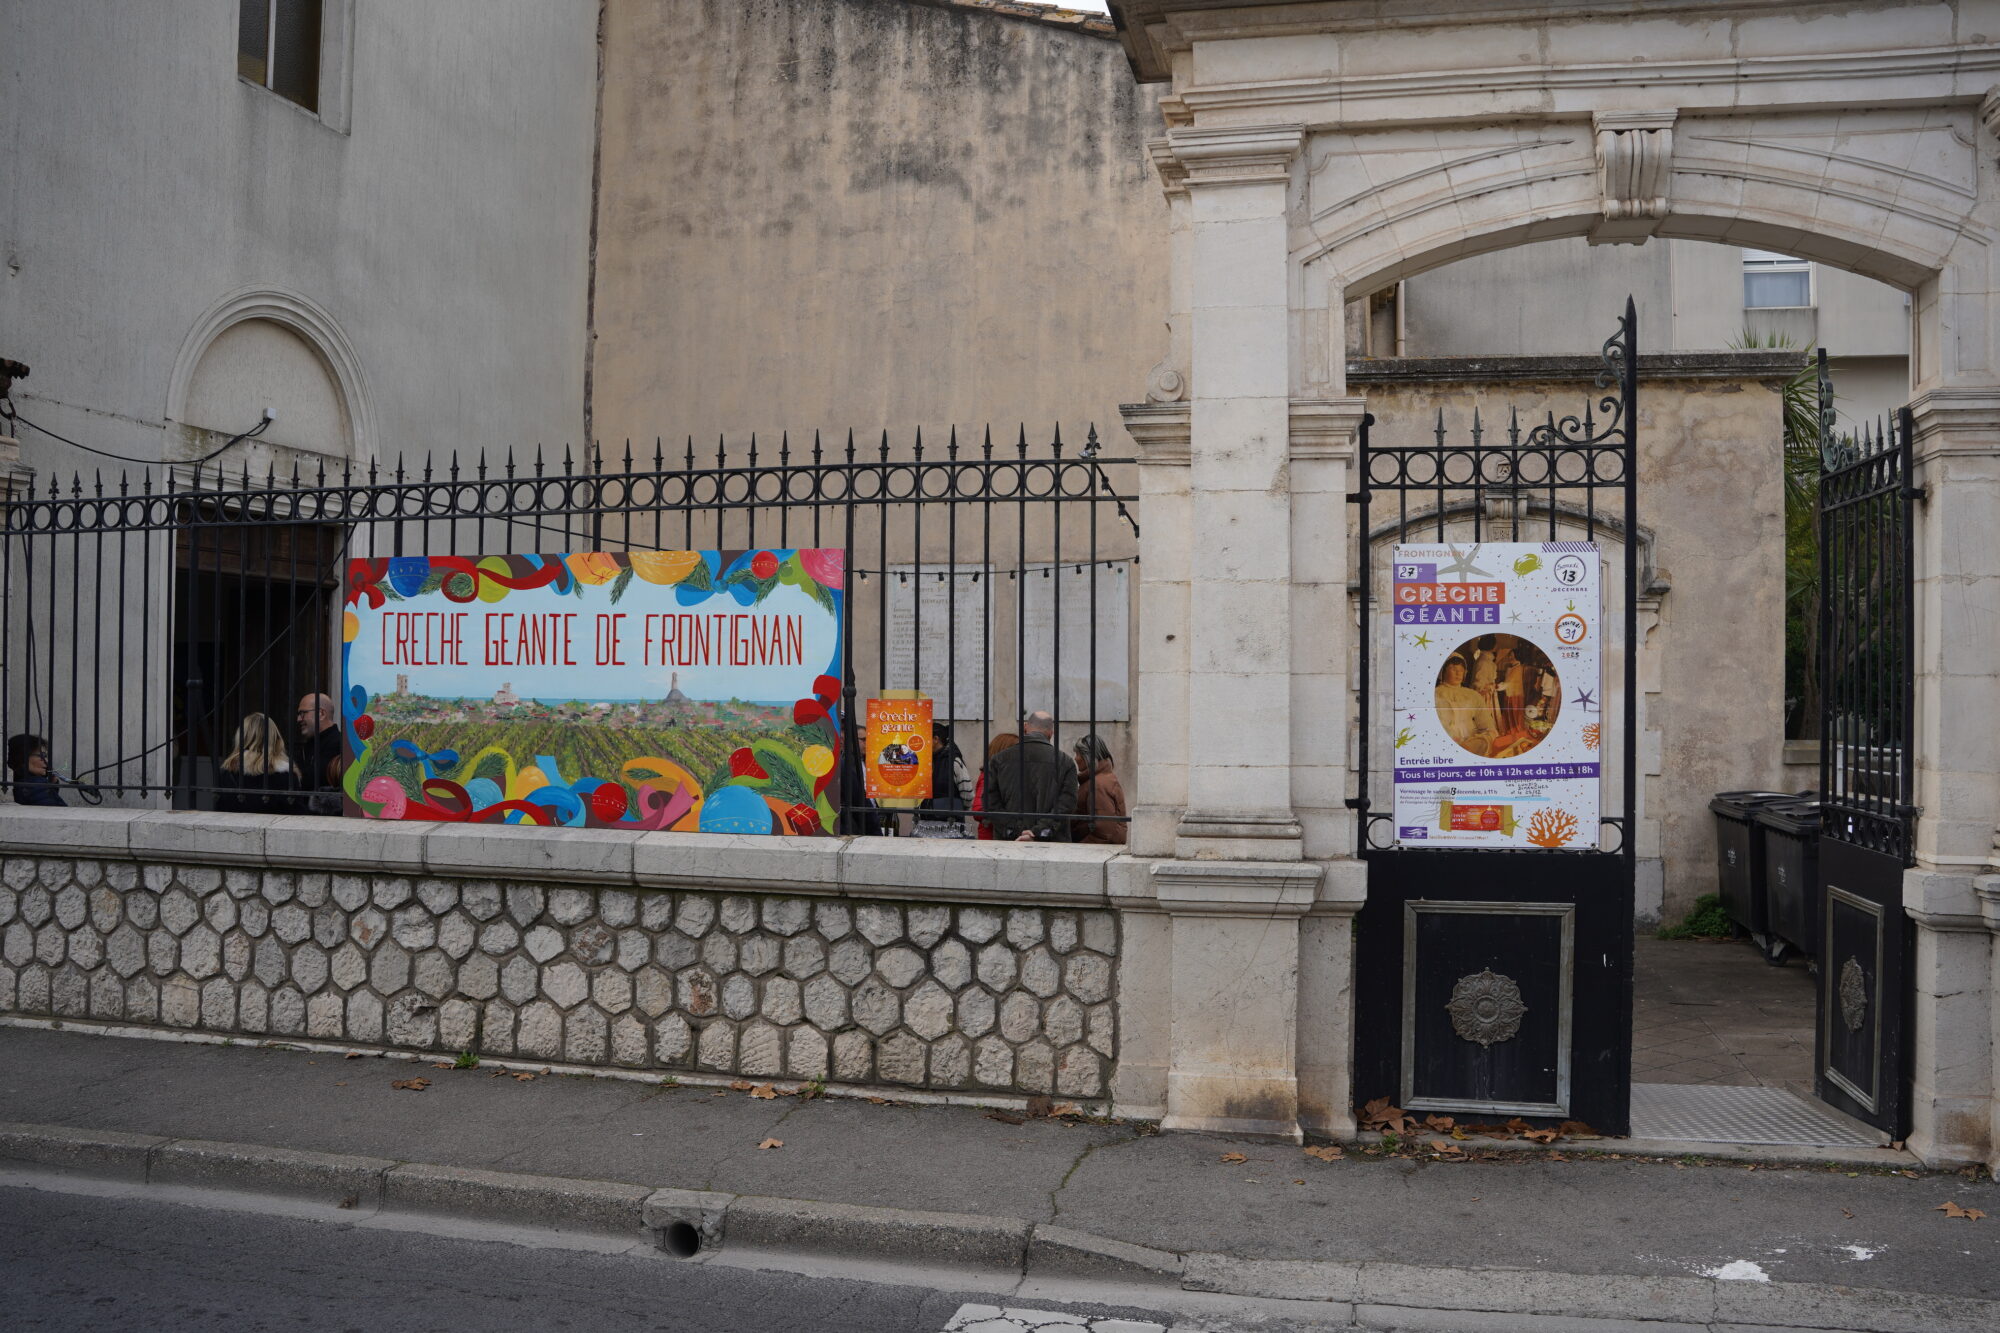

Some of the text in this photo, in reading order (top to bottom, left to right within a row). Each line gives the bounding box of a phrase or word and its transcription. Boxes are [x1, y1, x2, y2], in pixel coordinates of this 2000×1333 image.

[1398, 550, 1465, 558] FRONTIGNAN
[1562, 569, 1576, 582] 13
[1400, 583, 1498, 602] CRÈCHE
[1400, 604, 1494, 622] GÉANTE
[382, 612, 802, 666] CRECHE GEANTE DE FRONTIGNAN
[1563, 628, 1576, 640] 31
[1400, 756, 1454, 765] Entrée libre
[1400, 770, 1421, 779] Tous
[1423, 770, 1436, 778] les
[1438, 770, 1463, 780] jours,
[1465, 769, 1477, 777] de
[1480, 768, 1495, 777] 10h
[1506, 767, 1522, 776] 12h
[1536, 767, 1547, 775] de
[1550, 766, 1566, 775] 15h
[1578, 765, 1593, 774] 18h
